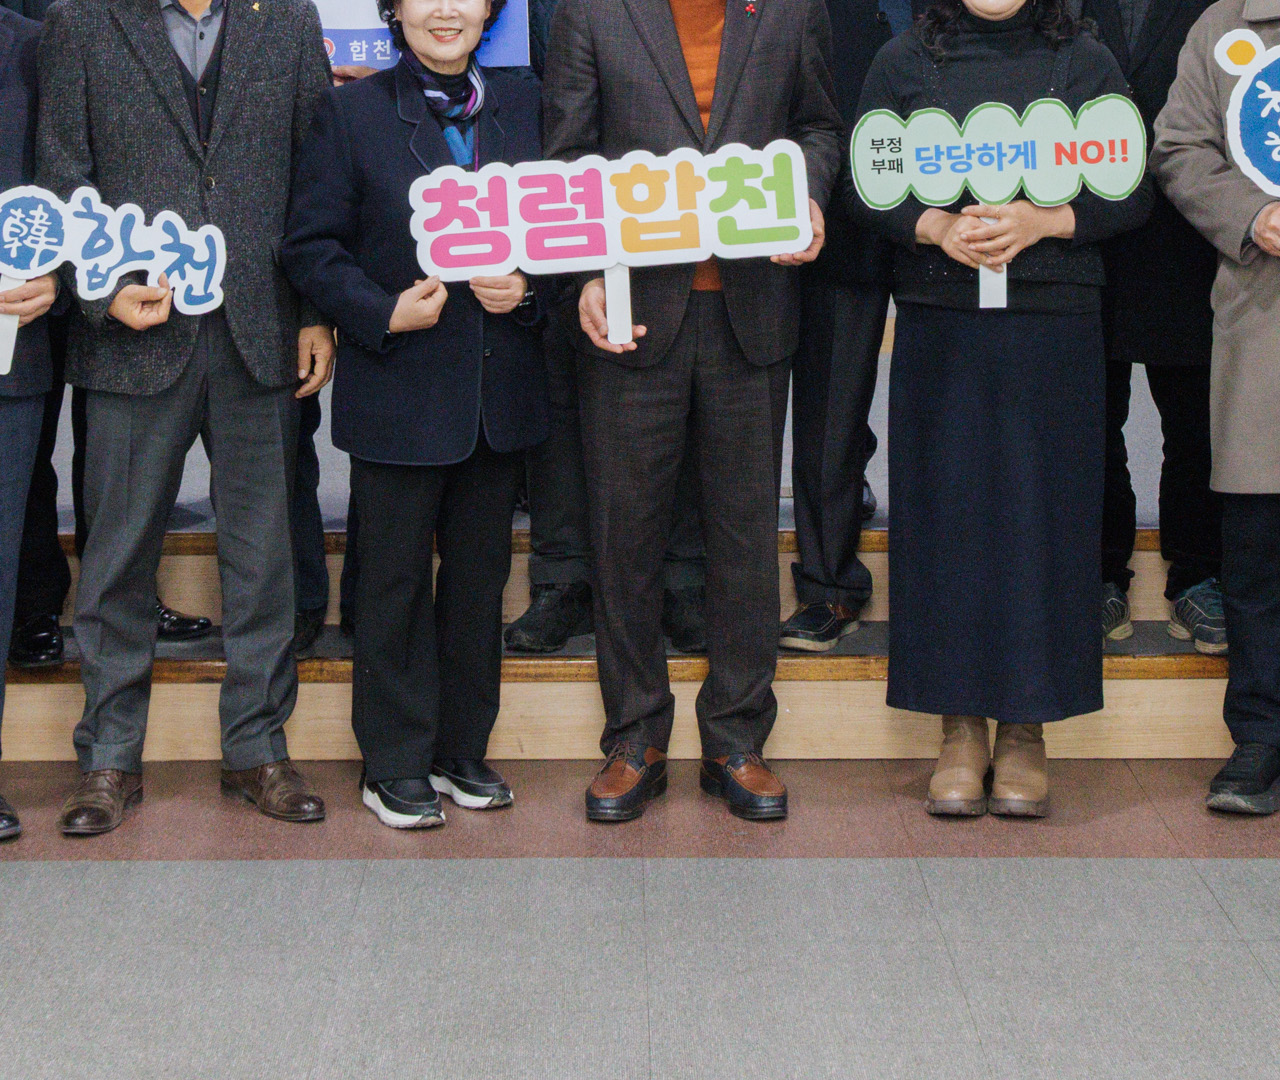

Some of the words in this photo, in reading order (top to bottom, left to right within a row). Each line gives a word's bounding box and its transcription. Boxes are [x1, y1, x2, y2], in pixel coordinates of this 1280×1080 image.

[348, 38, 403, 62] 합천
[870, 136, 903, 154] 부정
[915, 140, 1038, 175] 당당하게
[1054, 138, 1129, 166] NO!!
[871, 157, 904, 175] 부패
[422, 152, 801, 269] 청렴합천
